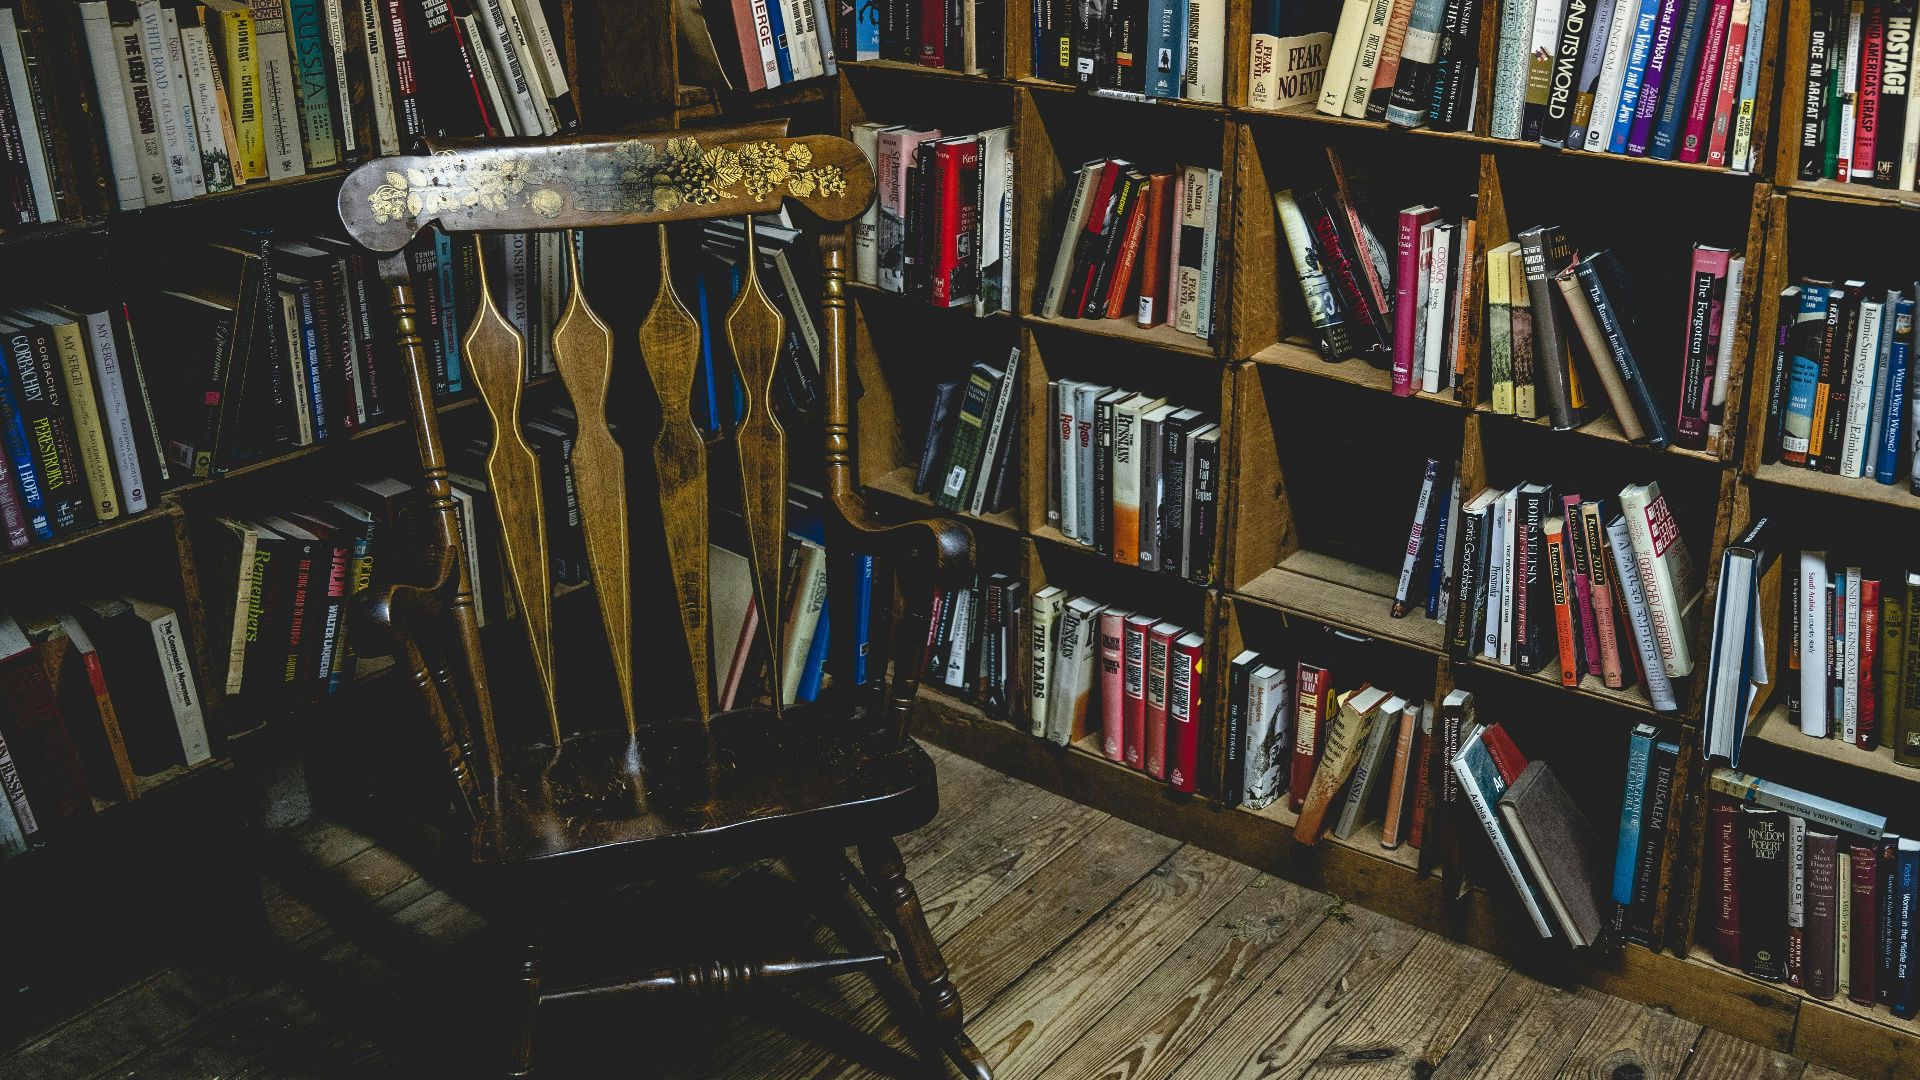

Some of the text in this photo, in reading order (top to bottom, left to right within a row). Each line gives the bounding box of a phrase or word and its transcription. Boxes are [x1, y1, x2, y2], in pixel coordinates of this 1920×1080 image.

[238, 20, 249, 62] MIDNIGHT
[367, 31, 378, 54] WAR
[392, 18, 408, 59] DISSIDENT
[469, 24, 479, 38] THE
[511, 16, 526, 46] MOSCOW
[1637, 13, 1656, 31] Tsar
[144, 14, 168, 89] WHITE ROAD
[295, 4, 325, 99] RUSSIA
[473, 39, 492, 80] HERMITAGE
[1253, 40, 1264, 79] NO EVIL
[1262, 46, 1272, 74] FEAR
[1288, 44, 1322, 71] FEAR
[1561, 35, 1579, 57] ITS
[1604, 17, 1624, 71] KINGDOM
[1630, 32, 1650, 65] Nicholas
[1650, 26, 1672, 72] KUWAIT
[1882, 17, 1912, 95] HOSTAGE
[123, 34, 155, 134] THE UGLY RUSSIAN
[241, 76, 255, 123] CHERNOBYL
[1548, 58, 1575, 119] WORLD
[1622, 90, 1638, 104] the
[1626, 72, 1640, 88] and
[1804, 31, 1825, 146] ONCE AN ARAFAT MAN
[1862, 42, 1879, 132] AMERICA'S GRASP
[1617, 105, 1633, 123] Jews
[1644, 86, 1659, 119] ZAHRA
[1185, 174, 1204, 219] Natan Sharansky
[1435, 247, 1446, 284] COSSACK
[1180, 270, 1188, 306] NO EVIL
[1188, 277, 1197, 302] FEAR
[1588, 284, 1633, 382] The Russian Intelligentsia
[1691, 277, 1712, 355] The Forgotten
[1861, 306, 1877, 342] Islamic
[62, 335, 81, 387] MY SERGEI
[97, 323, 115, 374] MY SERGEI
[1821, 303, 1837, 378] IRAQ UNDER SIEGE
[1855, 343, 1872, 379] Surveys
[36, 337, 59, 406] GORBACHEV
[1894, 368, 1905, 391] WHAT
[10, 335, 64, 490] GORBACHEV PERESTROIKA
[1891, 394, 1903, 417] WENT
[1117, 413, 1133, 464] RUSSIANS
[1843, 426, 1861, 475] Edinburgh
[1887, 419, 1900, 453] WRONG?
[20, 471, 39, 503] HOPE
[1434, 517, 1446, 568] SACRED SEA
[1460, 516, 1478, 601] Lenin's Grandchildren
[1527, 499, 1539, 584] BORIS YELTSIN
[1569, 508, 1586, 571] Russia 2010
[1588, 518, 1604, 582] Russia 2010
[1550, 546, 1564, 604] Russia 2010
[1808, 572, 1816, 590] Saudi
[246, 550, 271, 642] Remembers
[319, 548, 348, 678] STALIN WALTER LAQUEUR
[1618, 540, 1657, 661] A FAILED EMPIRE
[1640, 558, 1674, 659] GORBACHEV GENERATION
[1808, 592, 1816, 611] Arabia
[1062, 614, 1080, 659] RUSSIANS
[1133, 634, 1142, 661] THE NEW
[1807, 640, 1815, 654] study
[1847, 580, 1857, 675] INSIDE THE KINGDOM
[163, 621, 192, 707] The Communist Movement
[1034, 625, 1044, 698] THE YEARS
[1157, 644, 1166, 671] THE NEW
[1181, 656, 1190, 684] THE NEW
[1255, 687, 1264, 722] Ideologies
[1297, 693, 1317, 756] THE COMMUNISTS
[1450, 717, 1459, 758] PHARAOHS
[1348, 767, 1367, 805] RUSSIA
[1450, 787, 1458, 802] SUN
[1631, 753, 1647, 827] THE KINGDOM OF
[1470, 794, 1498, 841] Arabia Felix
[1639, 767, 1670, 903] JERUSALEM the living city
[1748, 829, 1785, 841] KINGDOM
[1760, 822, 1774, 831] THE
[1751, 841, 1781, 852] ROBERT
[1810, 861, 1833, 869] History
[1722, 822, 1732, 920] The Arab World Today
[1901, 894, 1910, 919] Women
[1899, 941, 1908, 962] Middle
[1901, 929, 1909, 940] the
[1898, 964, 1907, 979] East
